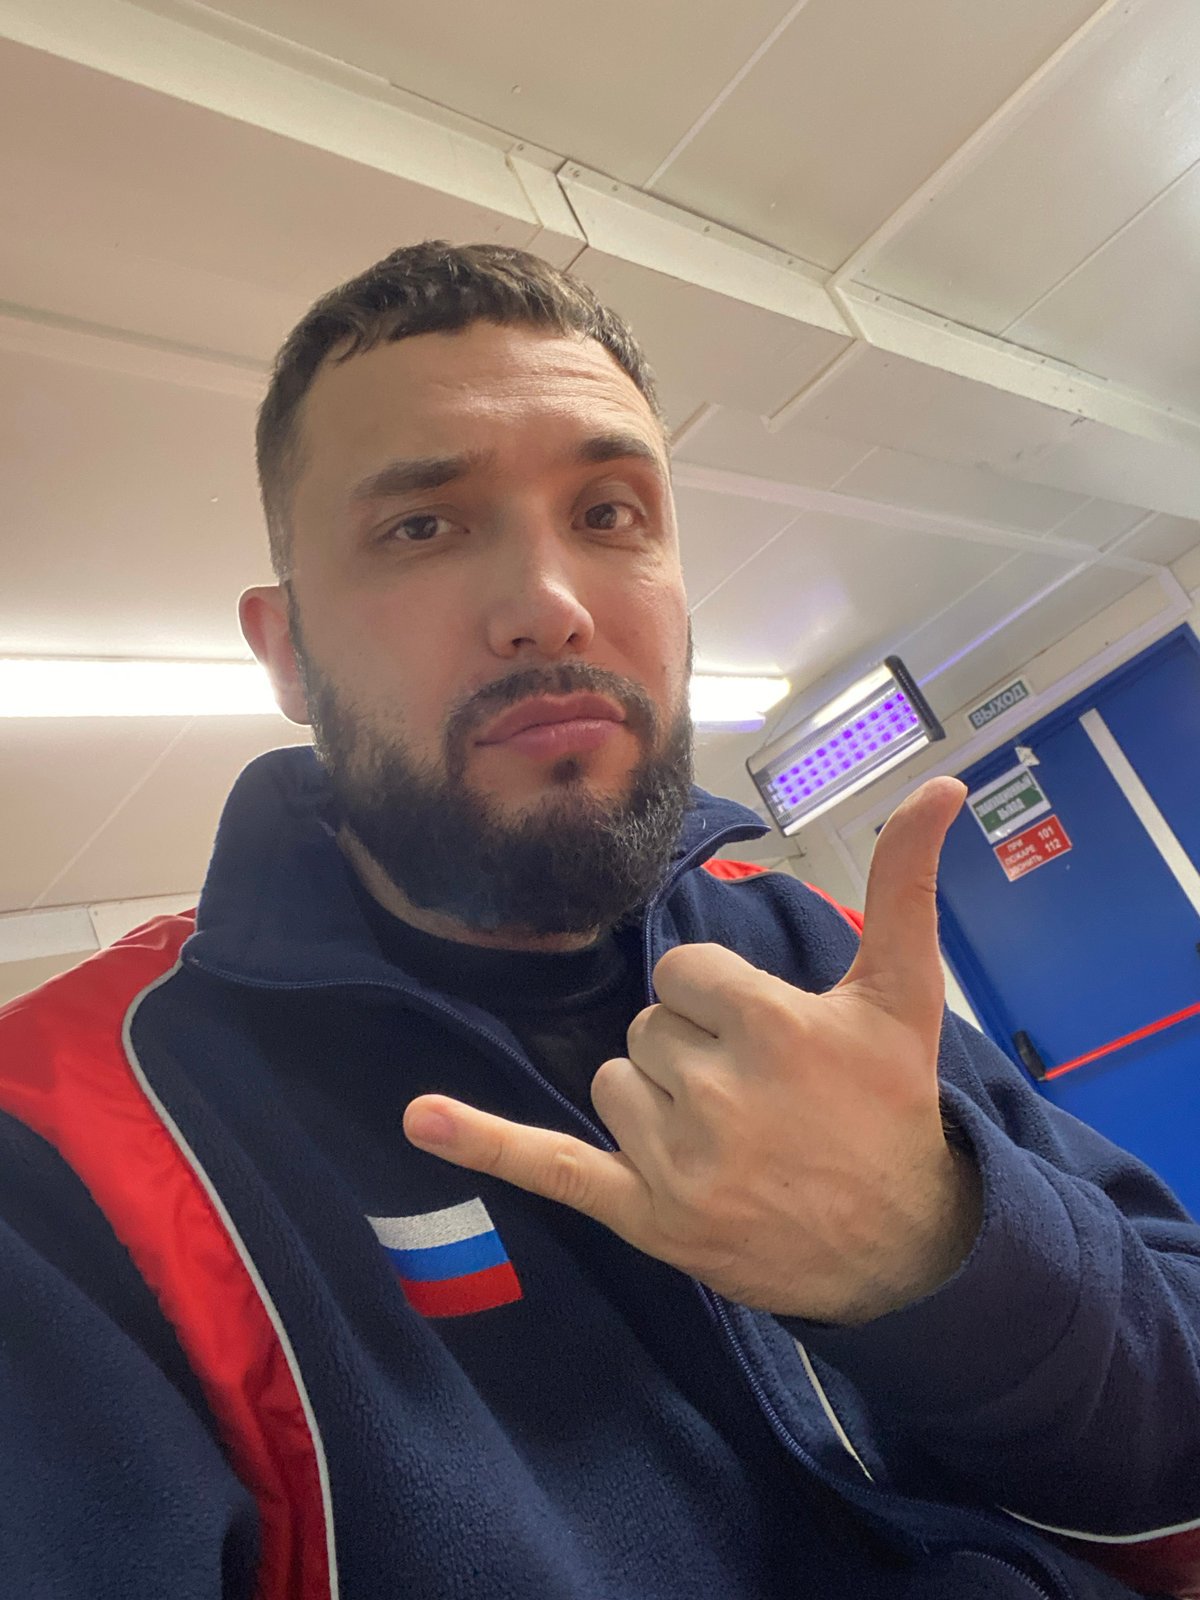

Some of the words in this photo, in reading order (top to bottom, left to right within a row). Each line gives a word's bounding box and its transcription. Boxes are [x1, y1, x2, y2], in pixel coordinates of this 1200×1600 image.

[971, 684, 1026, 726] ВЫХОД
[1038, 825, 1055, 841] 101
[1045, 838, 1062, 853] 112
